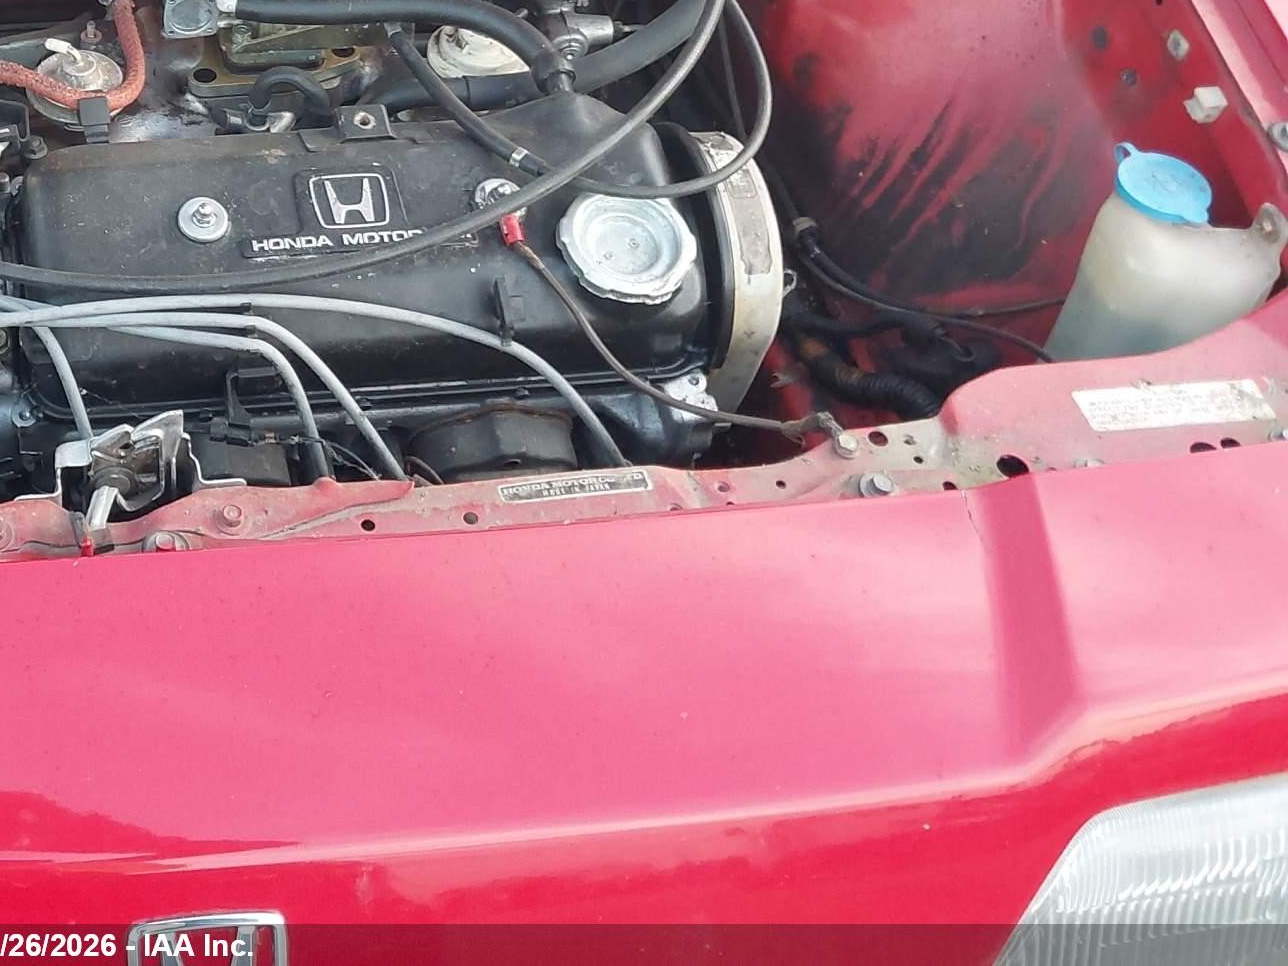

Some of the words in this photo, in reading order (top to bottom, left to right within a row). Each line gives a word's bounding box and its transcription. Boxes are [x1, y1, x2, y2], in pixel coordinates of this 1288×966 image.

[252, 234, 333, 252] HONDA
[502, 483, 550, 495] HONDA
[550, 477, 597, 490] MOTOR
[542, 487, 565, 496] MADE
[585, 483, 610, 492] JAPAN
